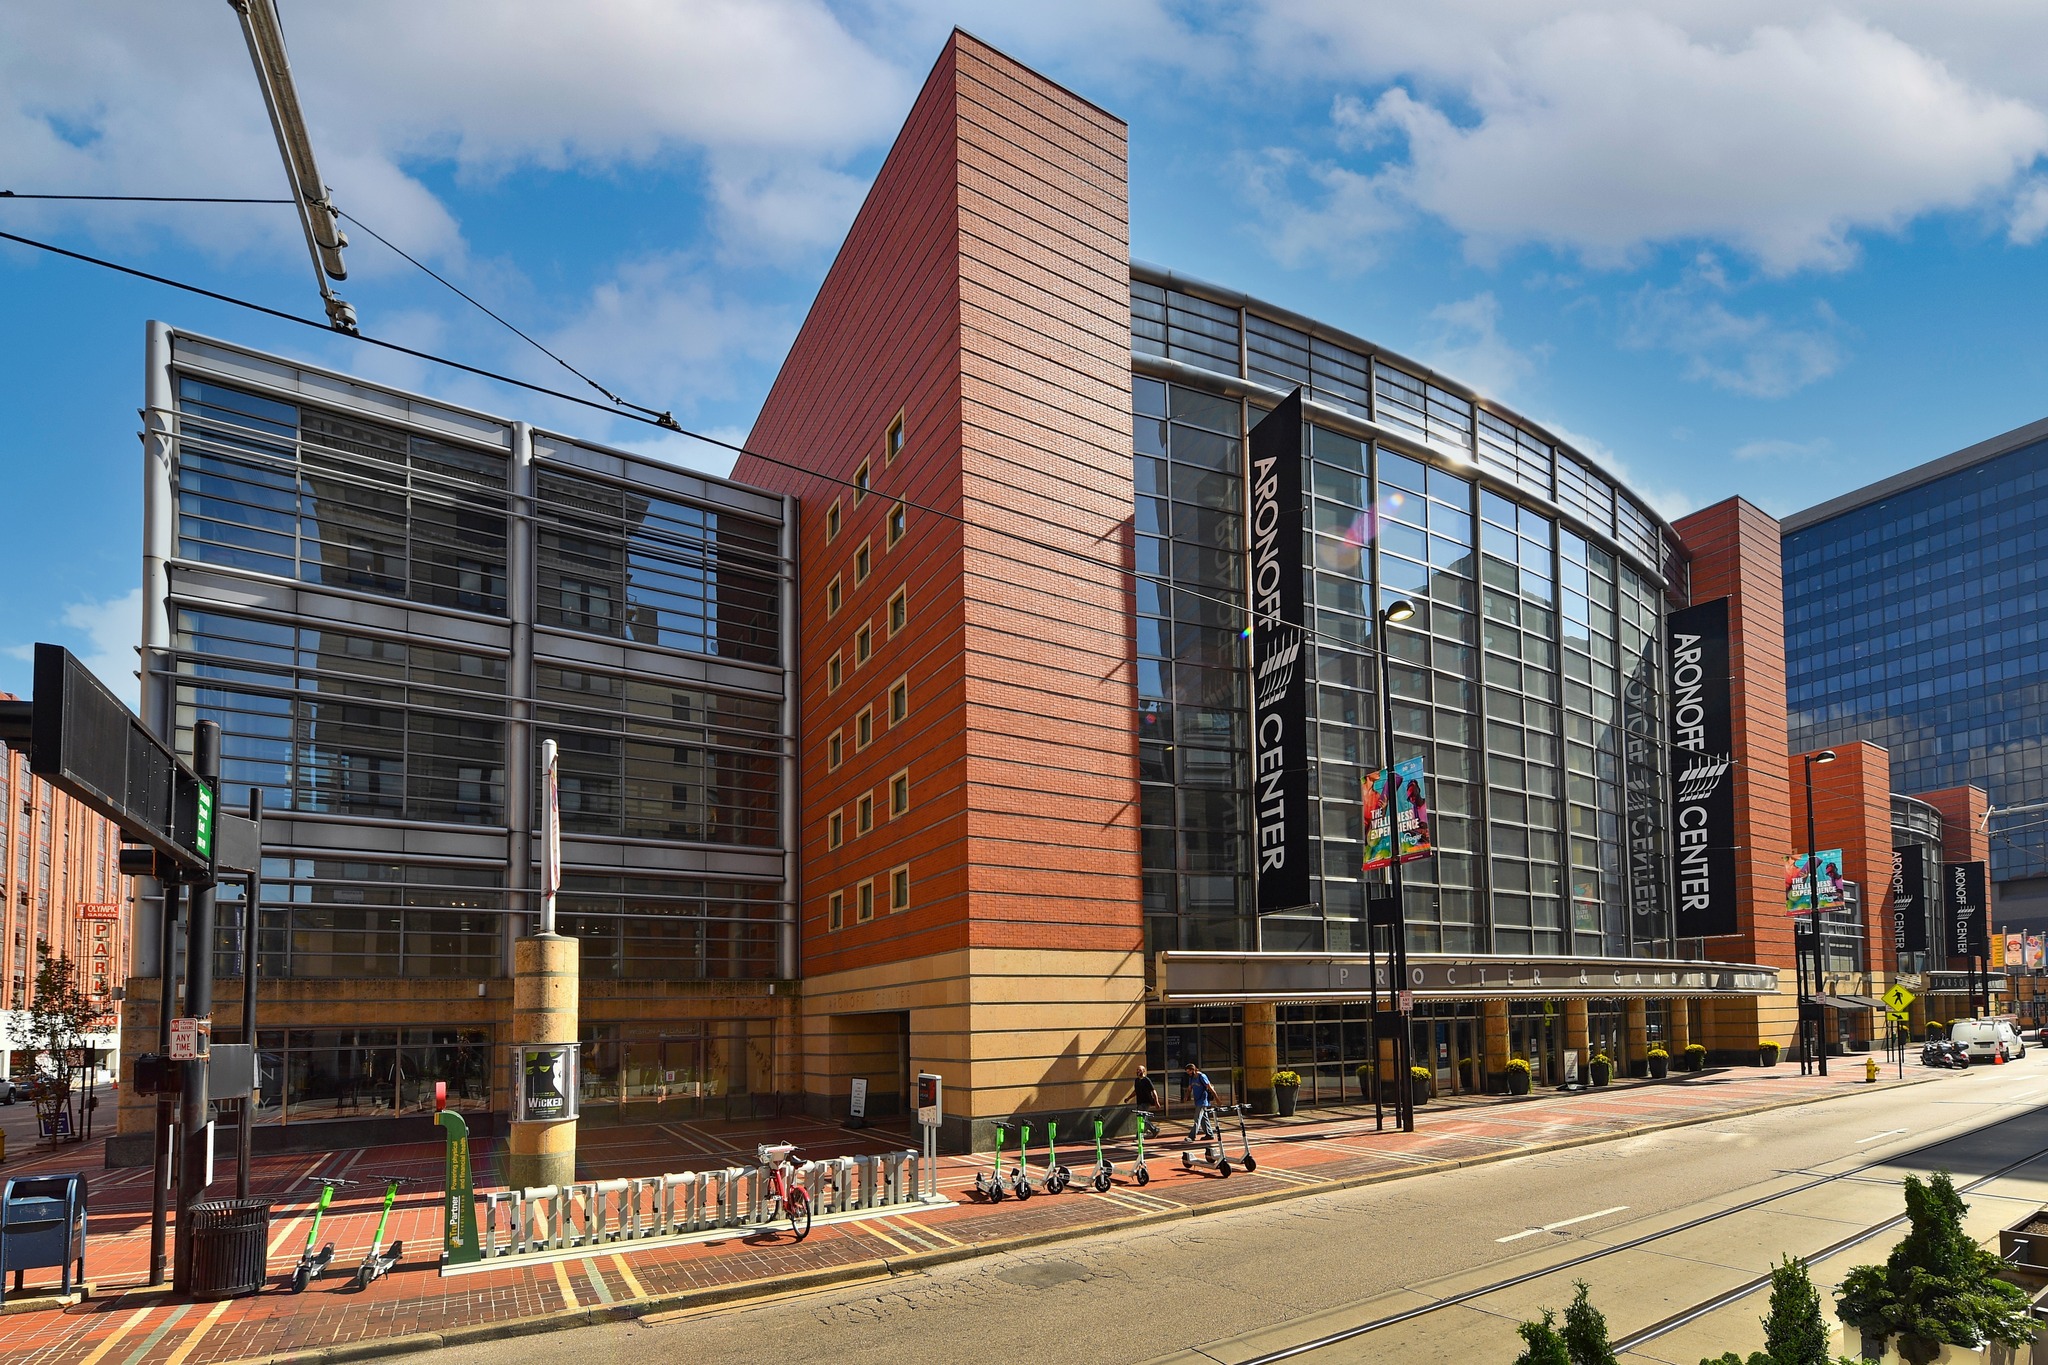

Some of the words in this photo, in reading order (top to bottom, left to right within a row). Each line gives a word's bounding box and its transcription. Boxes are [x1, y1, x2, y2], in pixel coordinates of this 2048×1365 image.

[1254, 456, 1281, 632] ARONOFF
[1674, 634, 1704, 751] ARONOFF
[1259, 713, 1285, 874] CENTER
[1370, 808, 1383, 819] THE
[1400, 832, 1422, 845] Kroger
[1679, 806, 1710, 912] CENTER
[1892, 851, 1904, 894] ARONOFF
[1955, 866, 1966, 905] ARONOFF
[87, 904, 117, 913] OLYMPIC
[1894, 912, 1905, 948] CENTER
[1956, 920, 1968, 954] CENTER
[1339, 968, 1541, 986] PROCTER
[1579, 968, 1589, 985] &
[1613, 969, 1705, 986] GAMBLE
[175, 1033, 192, 1042] ANY
[175, 1042, 192, 1051] TIME
[451, 1141, 459, 1163] physical
[451, 1164, 459, 1190] Powering
[449, 1195, 459, 1238] TruPartner
